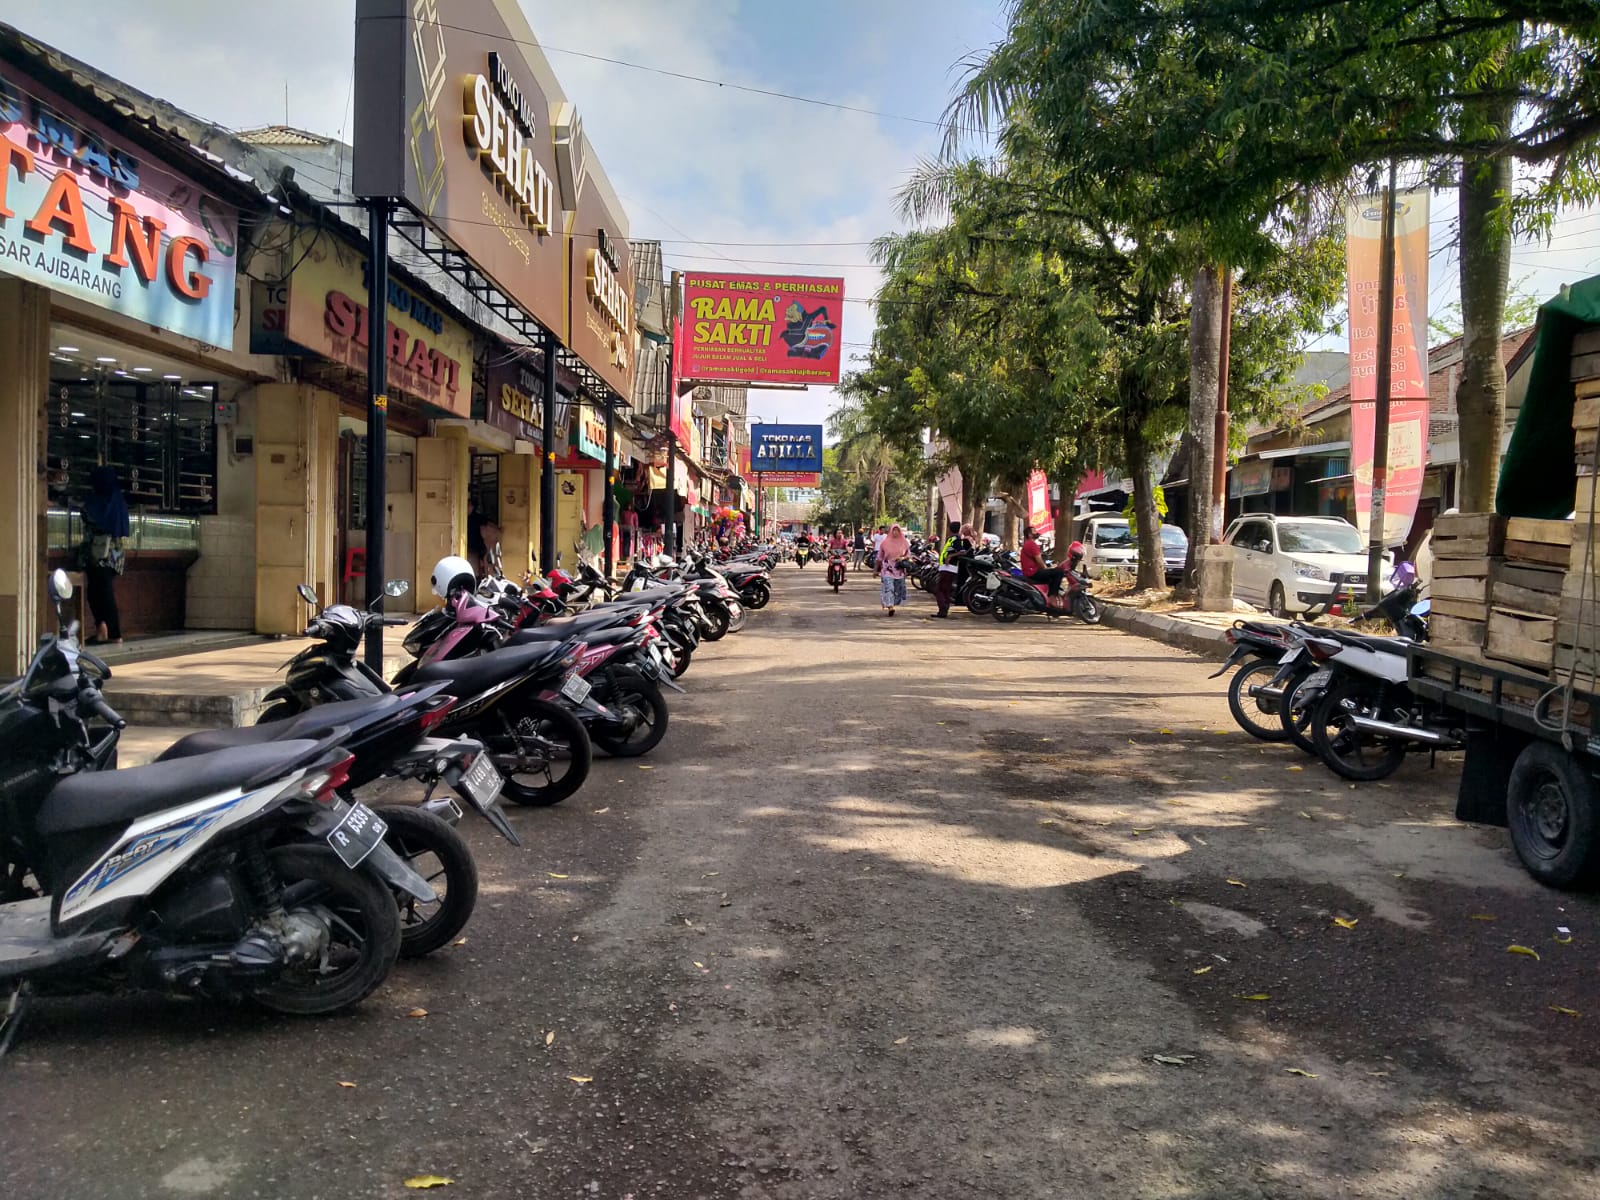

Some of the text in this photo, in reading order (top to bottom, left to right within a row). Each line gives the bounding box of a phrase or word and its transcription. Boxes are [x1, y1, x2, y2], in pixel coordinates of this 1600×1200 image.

[496, 50, 535, 139] TOKO MAS
[38, 109, 140, 190] MAS
[473, 73, 553, 237] SEHATI
[35, 251, 122, 299] AJIBARANG
[593, 249, 628, 335] SEHATI
[690, 279, 839, 294] PUSAT EMAS & PERHIASAN
[411, 297, 443, 335] MAS
[690, 297, 776, 322] RAMA
[693, 322, 772, 346] SAKTI
[756, 444, 816, 459] ADILLA
[762, 434, 788, 442] TOKO
[335, 830, 350, 847] R
[347, 809, 369, 833] 6339
